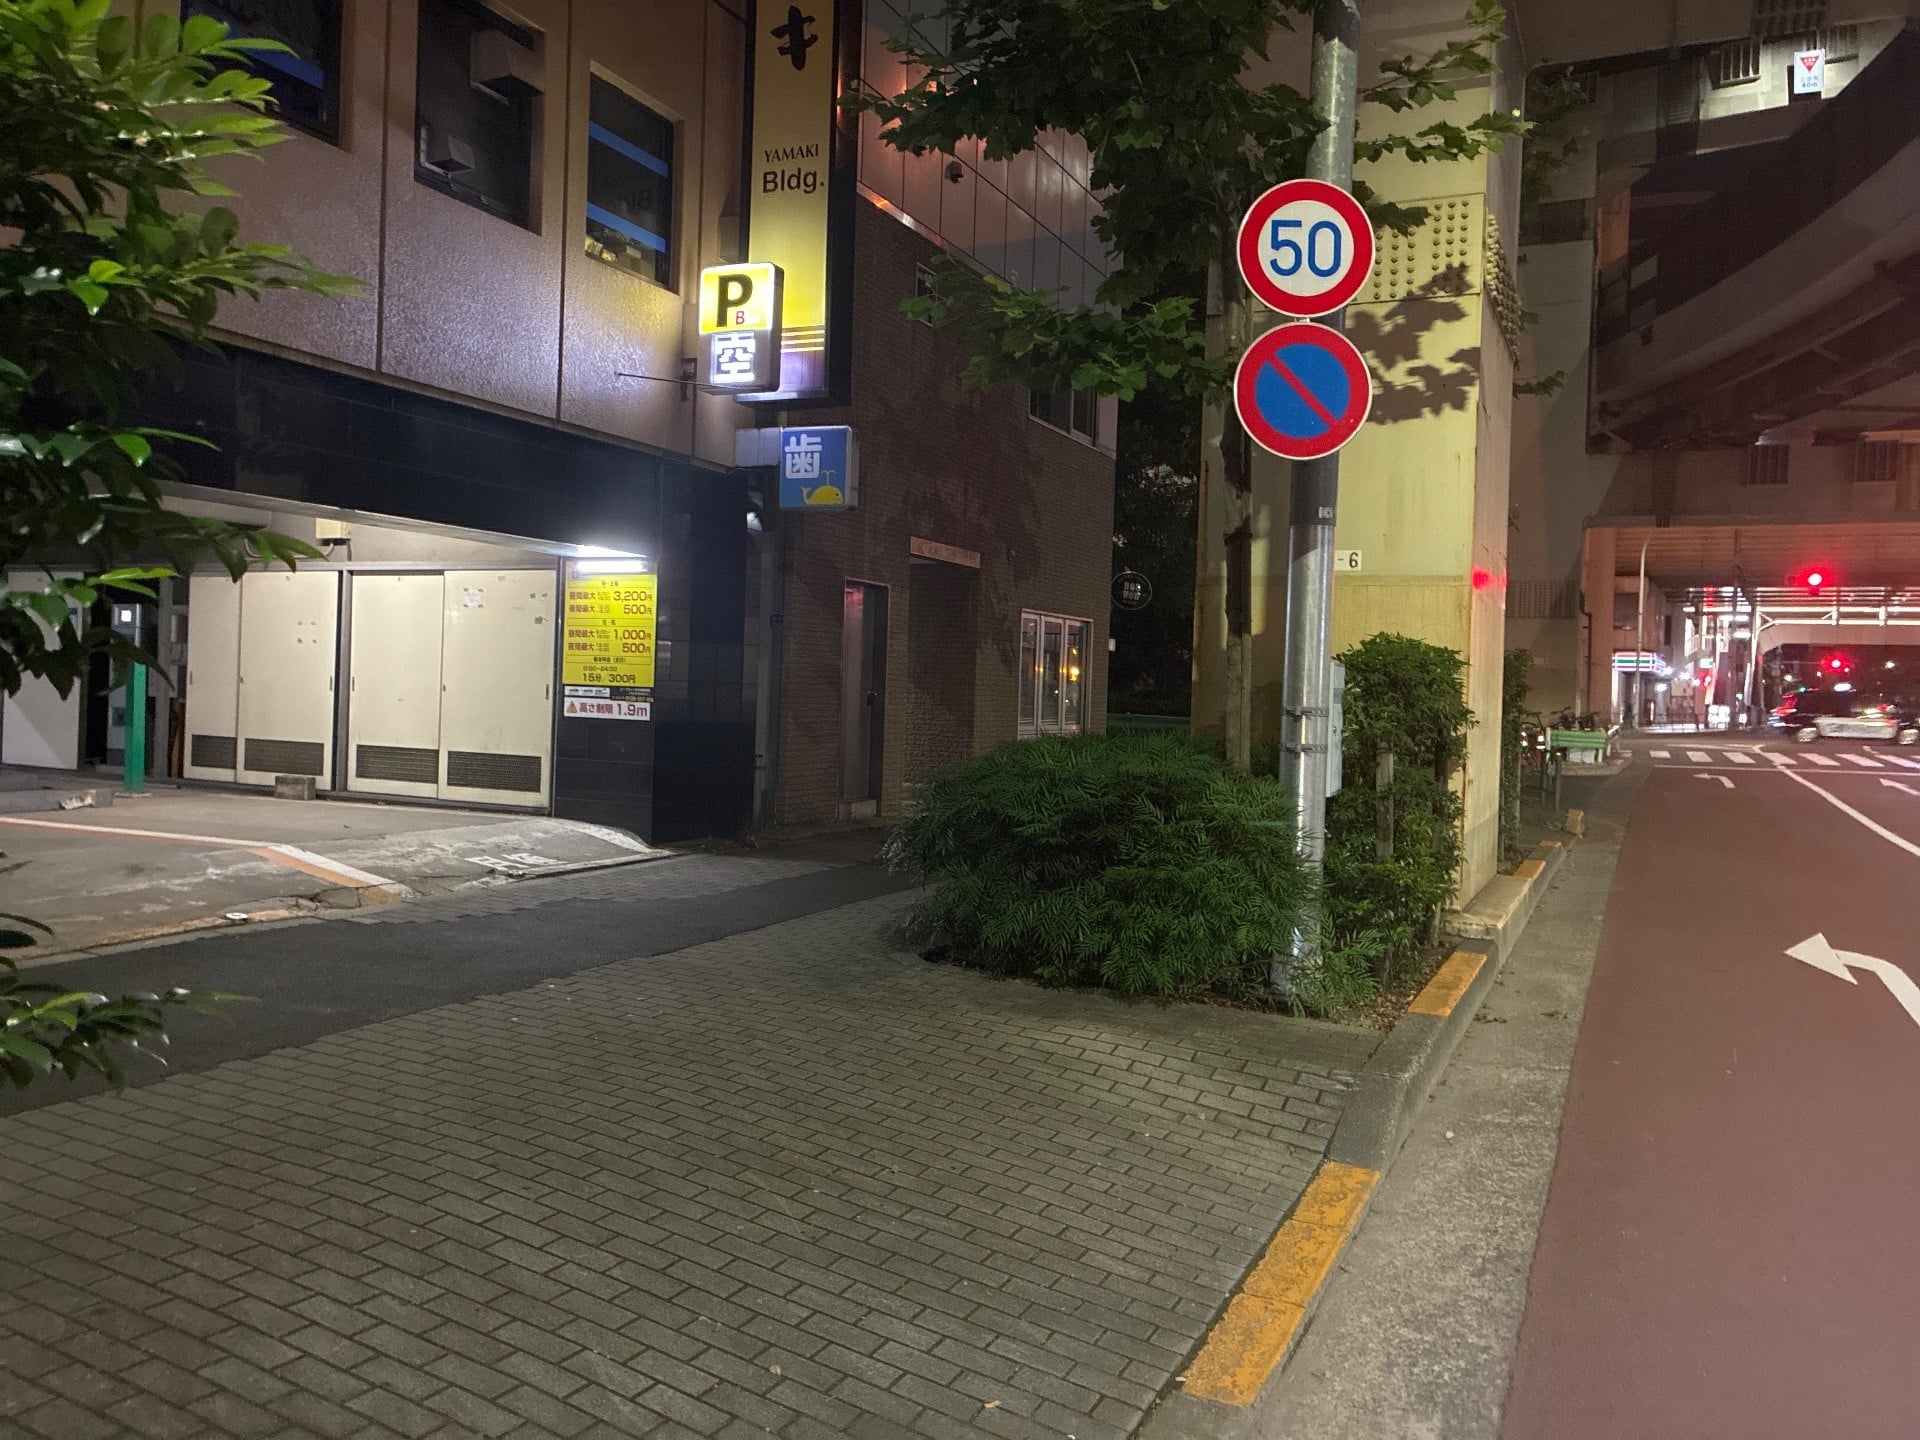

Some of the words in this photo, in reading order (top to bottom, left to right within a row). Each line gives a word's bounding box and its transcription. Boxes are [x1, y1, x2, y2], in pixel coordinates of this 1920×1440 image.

[764, 143, 819, 163] YAMAKI
[762, 167, 825, 194] Bldg.
[1269, 219, 1342, 278] 50
[715, 273, 753, 328] P
[784, 433, 823, 479] 歯
[617, 703, 648, 717] 1.9m
